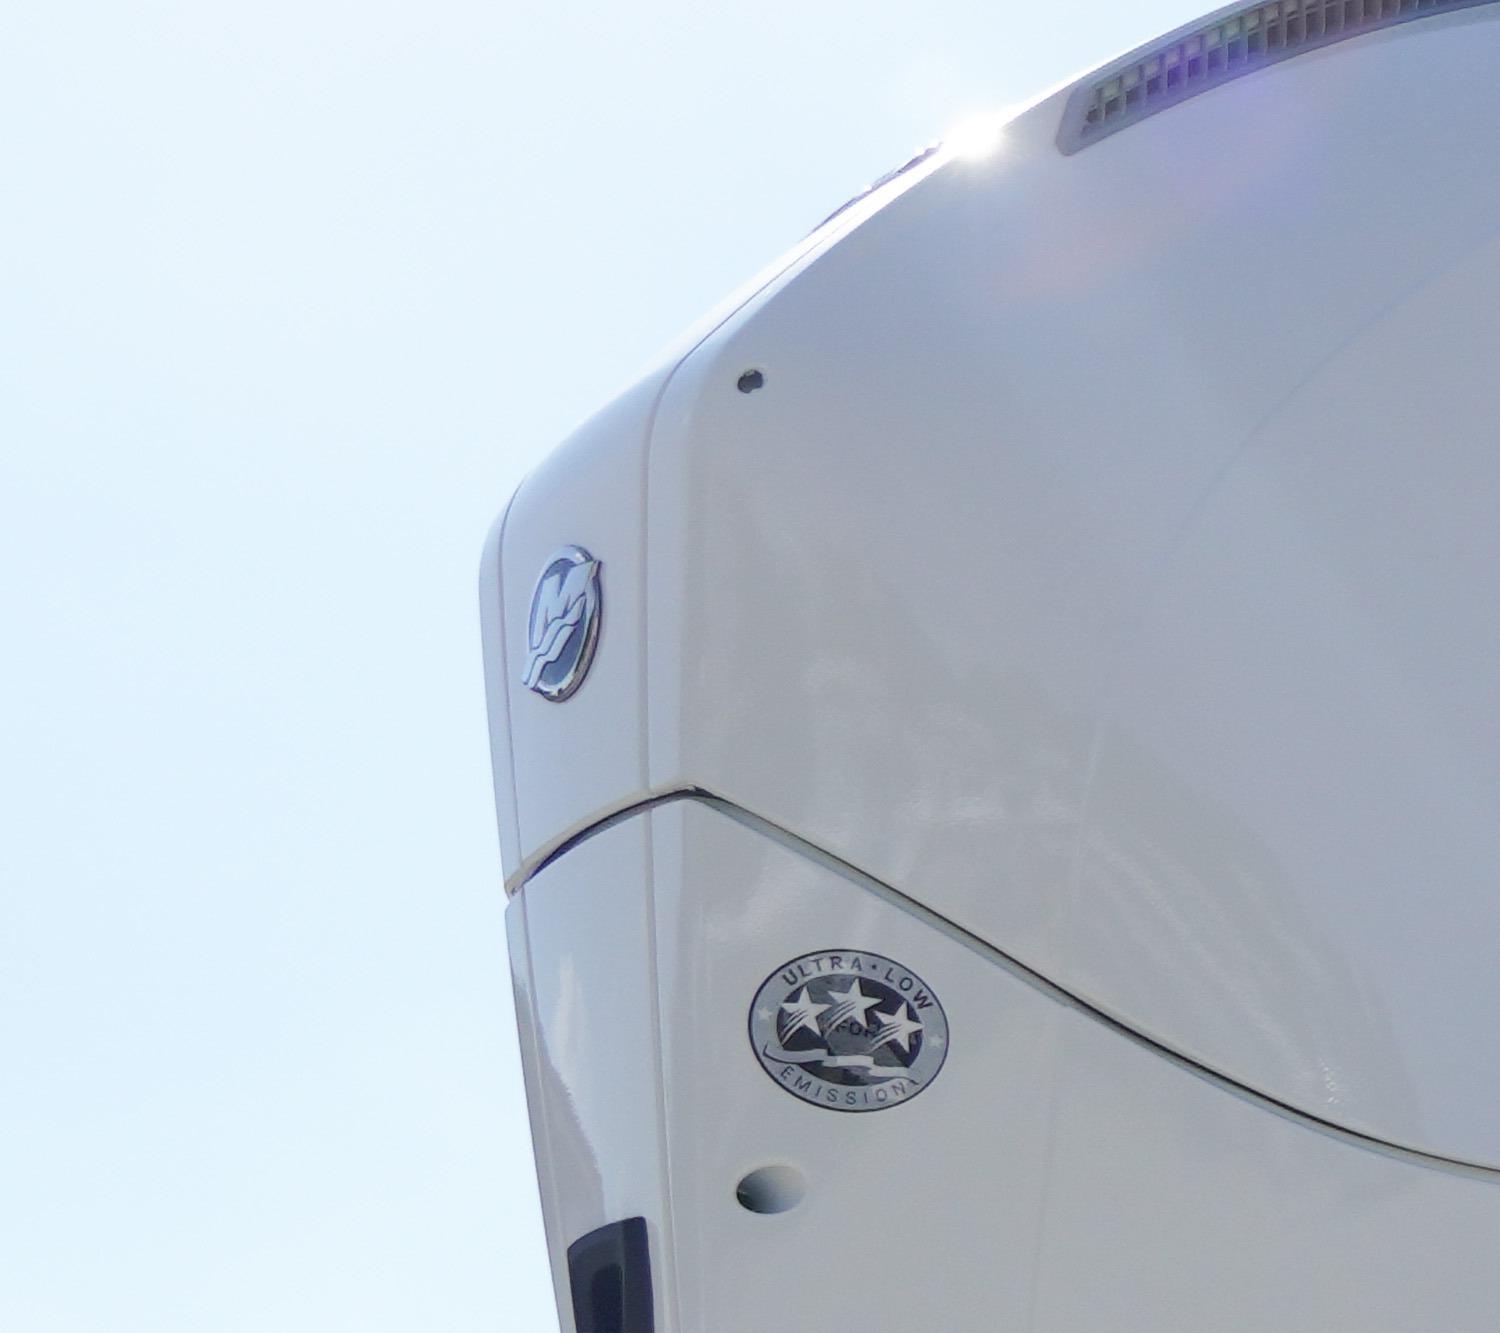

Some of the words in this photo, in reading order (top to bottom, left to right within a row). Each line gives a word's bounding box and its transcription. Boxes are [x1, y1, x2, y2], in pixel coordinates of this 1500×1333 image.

[782, 955, 863, 987] ULTRA
[884, 966, 933, 1011] LOW
[780, 1064, 907, 1105] EMISSION
